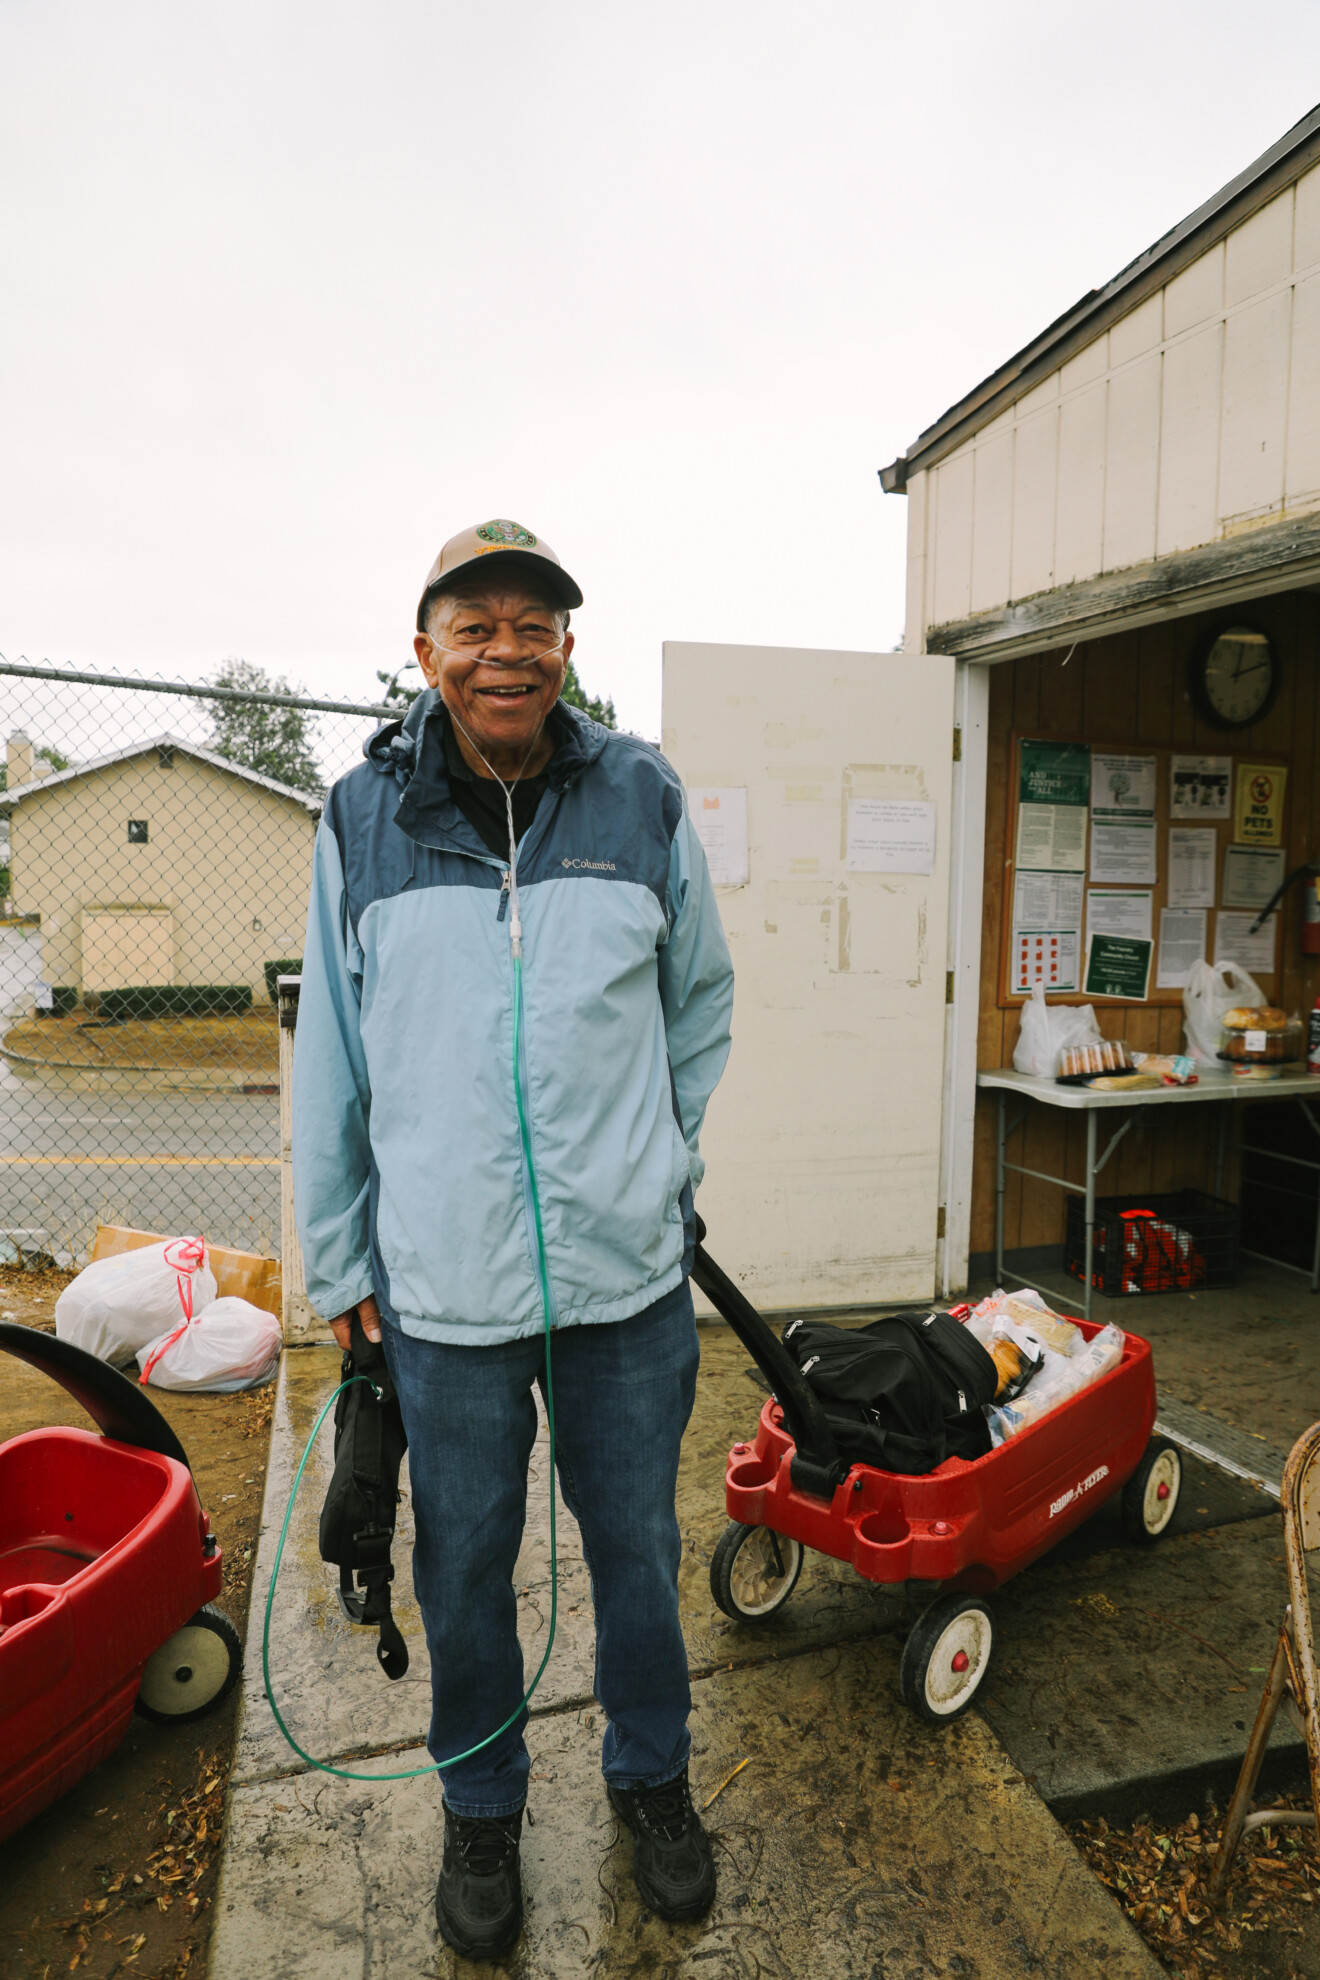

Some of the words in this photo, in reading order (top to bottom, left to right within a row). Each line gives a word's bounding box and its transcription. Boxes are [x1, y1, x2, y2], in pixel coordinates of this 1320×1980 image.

[1028, 771, 1047, 779] AND
[1028, 779, 1063, 788] JUSTICE
[1037, 787, 1053, 795] ALL
[1251, 804, 1269, 815] NO
[1244, 816, 1273, 829] PETS
[572, 858, 616, 871] Columbia
[1084, 1465, 1110, 1492] FLYER
